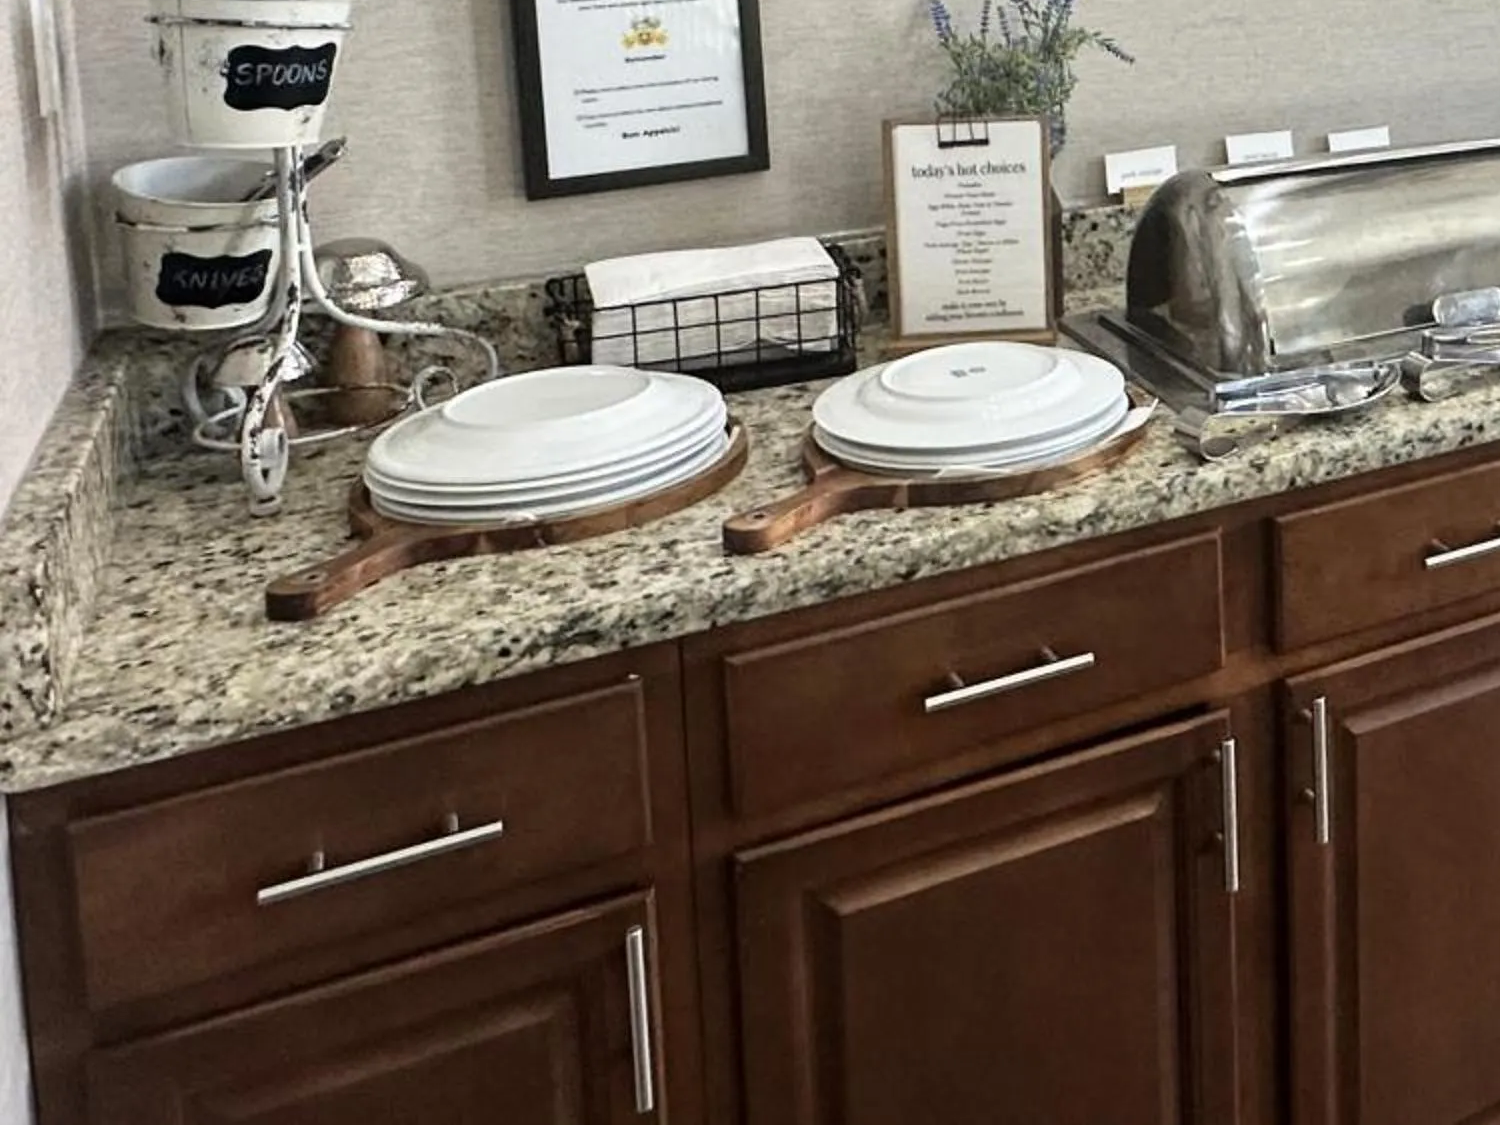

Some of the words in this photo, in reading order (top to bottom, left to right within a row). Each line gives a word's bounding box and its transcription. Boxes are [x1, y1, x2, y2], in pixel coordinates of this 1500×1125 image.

[235, 58, 328, 86] SPOONS
[911, 162, 955, 179] today's
[957, 160, 978, 176] hot
[980, 159, 1026, 176] choices
[173, 264, 265, 288] KNIVES
